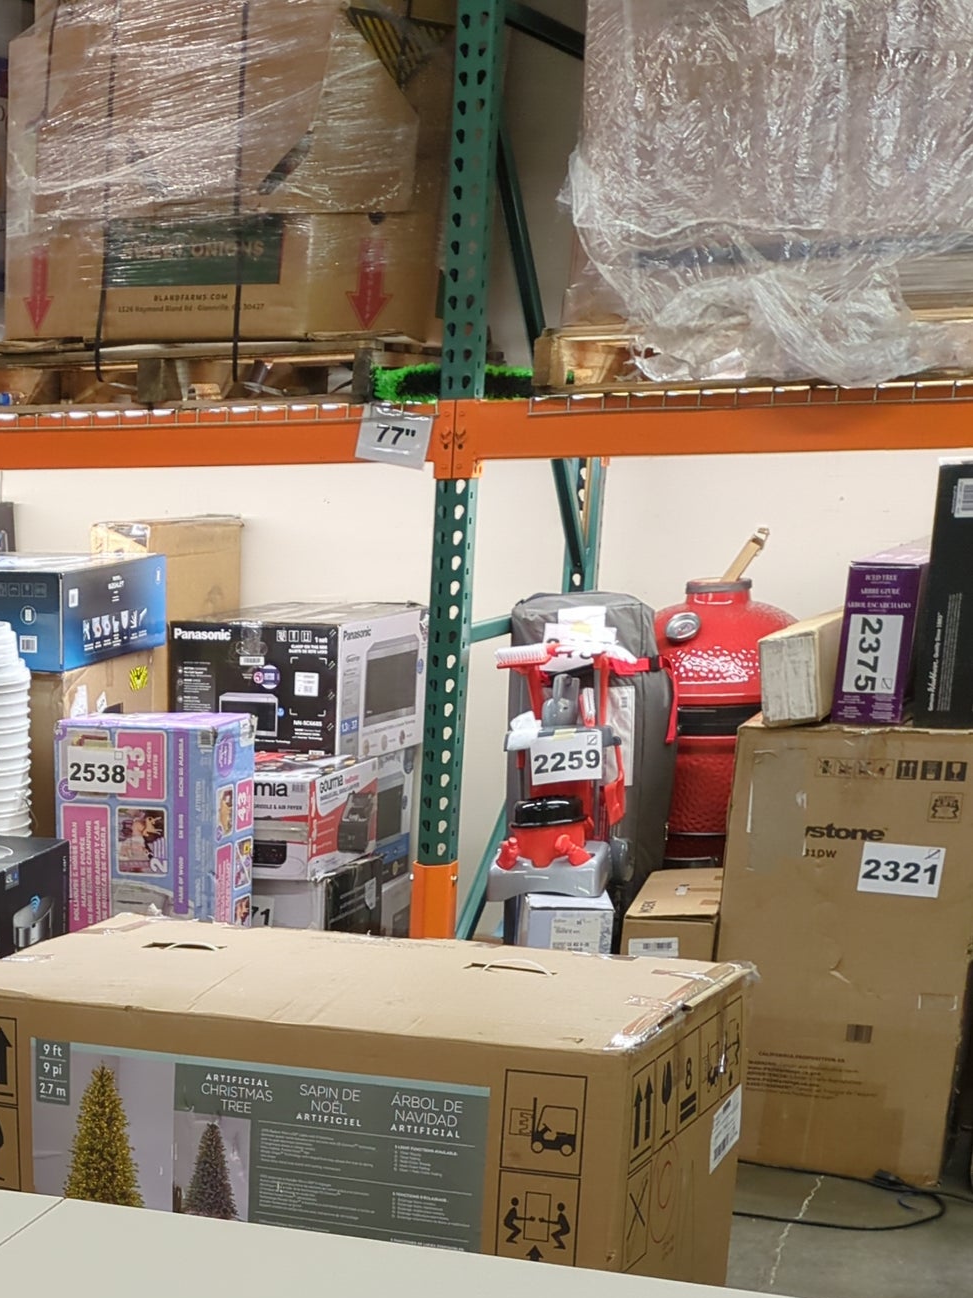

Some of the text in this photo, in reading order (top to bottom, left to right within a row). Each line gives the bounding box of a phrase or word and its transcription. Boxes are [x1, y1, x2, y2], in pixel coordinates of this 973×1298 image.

[376, 423, 416, 446] 77"
[173, 628, 232, 642] Panasonic
[342, 626, 372, 641] Panasonic
[854, 616, 884, 692] 2375
[533, 749, 600, 775] 2259
[69, 763, 126, 784] 2538
[861, 858, 938, 885] 2321
[42, 1043, 63, 1058] 9 ft
[42, 1062, 63, 1078] 9 pi
[205, 1073, 270, 1088] ARTIFICIAL
[39, 1081, 66, 1097] 2.7 m
[201, 1082, 273, 1103] CHRISTMAS
[299, 1083, 361, 1102] SAPIN DE
[220, 1098, 252, 1114] TREE
[310, 1099, 347, 1115] NOËL
[391, 1091, 463, 1113] ÁRBOL DE
[296, 1113, 362, 1127] ARTIFICIEL
[394, 1109, 458, 1128] NAVIDAD
[390, 1124, 461, 1138] ARTIFICIAL
